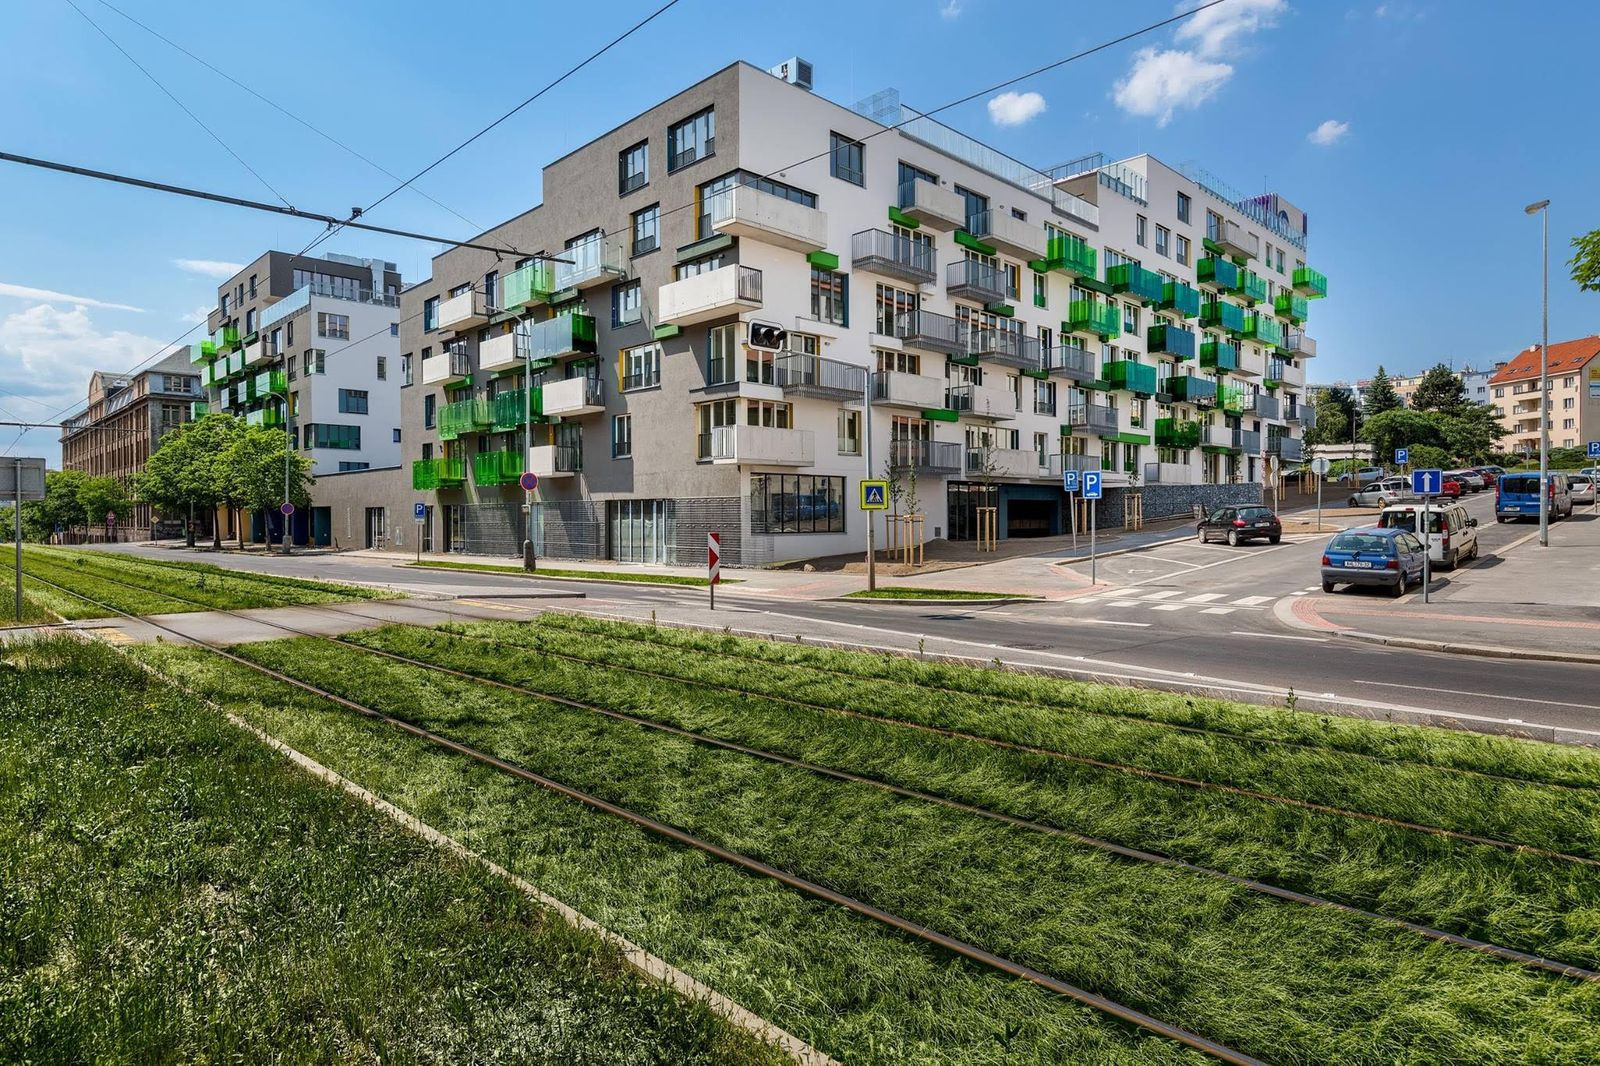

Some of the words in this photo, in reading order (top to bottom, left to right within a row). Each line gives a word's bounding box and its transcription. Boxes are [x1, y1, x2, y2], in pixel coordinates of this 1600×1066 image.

[1592, 443, 1600, 452] P
[1398, 450, 1405, 460] P
[1067, 473, 1076, 484] P
[1087, 475, 1097, 490] P
[417, 505, 423, 514] P
